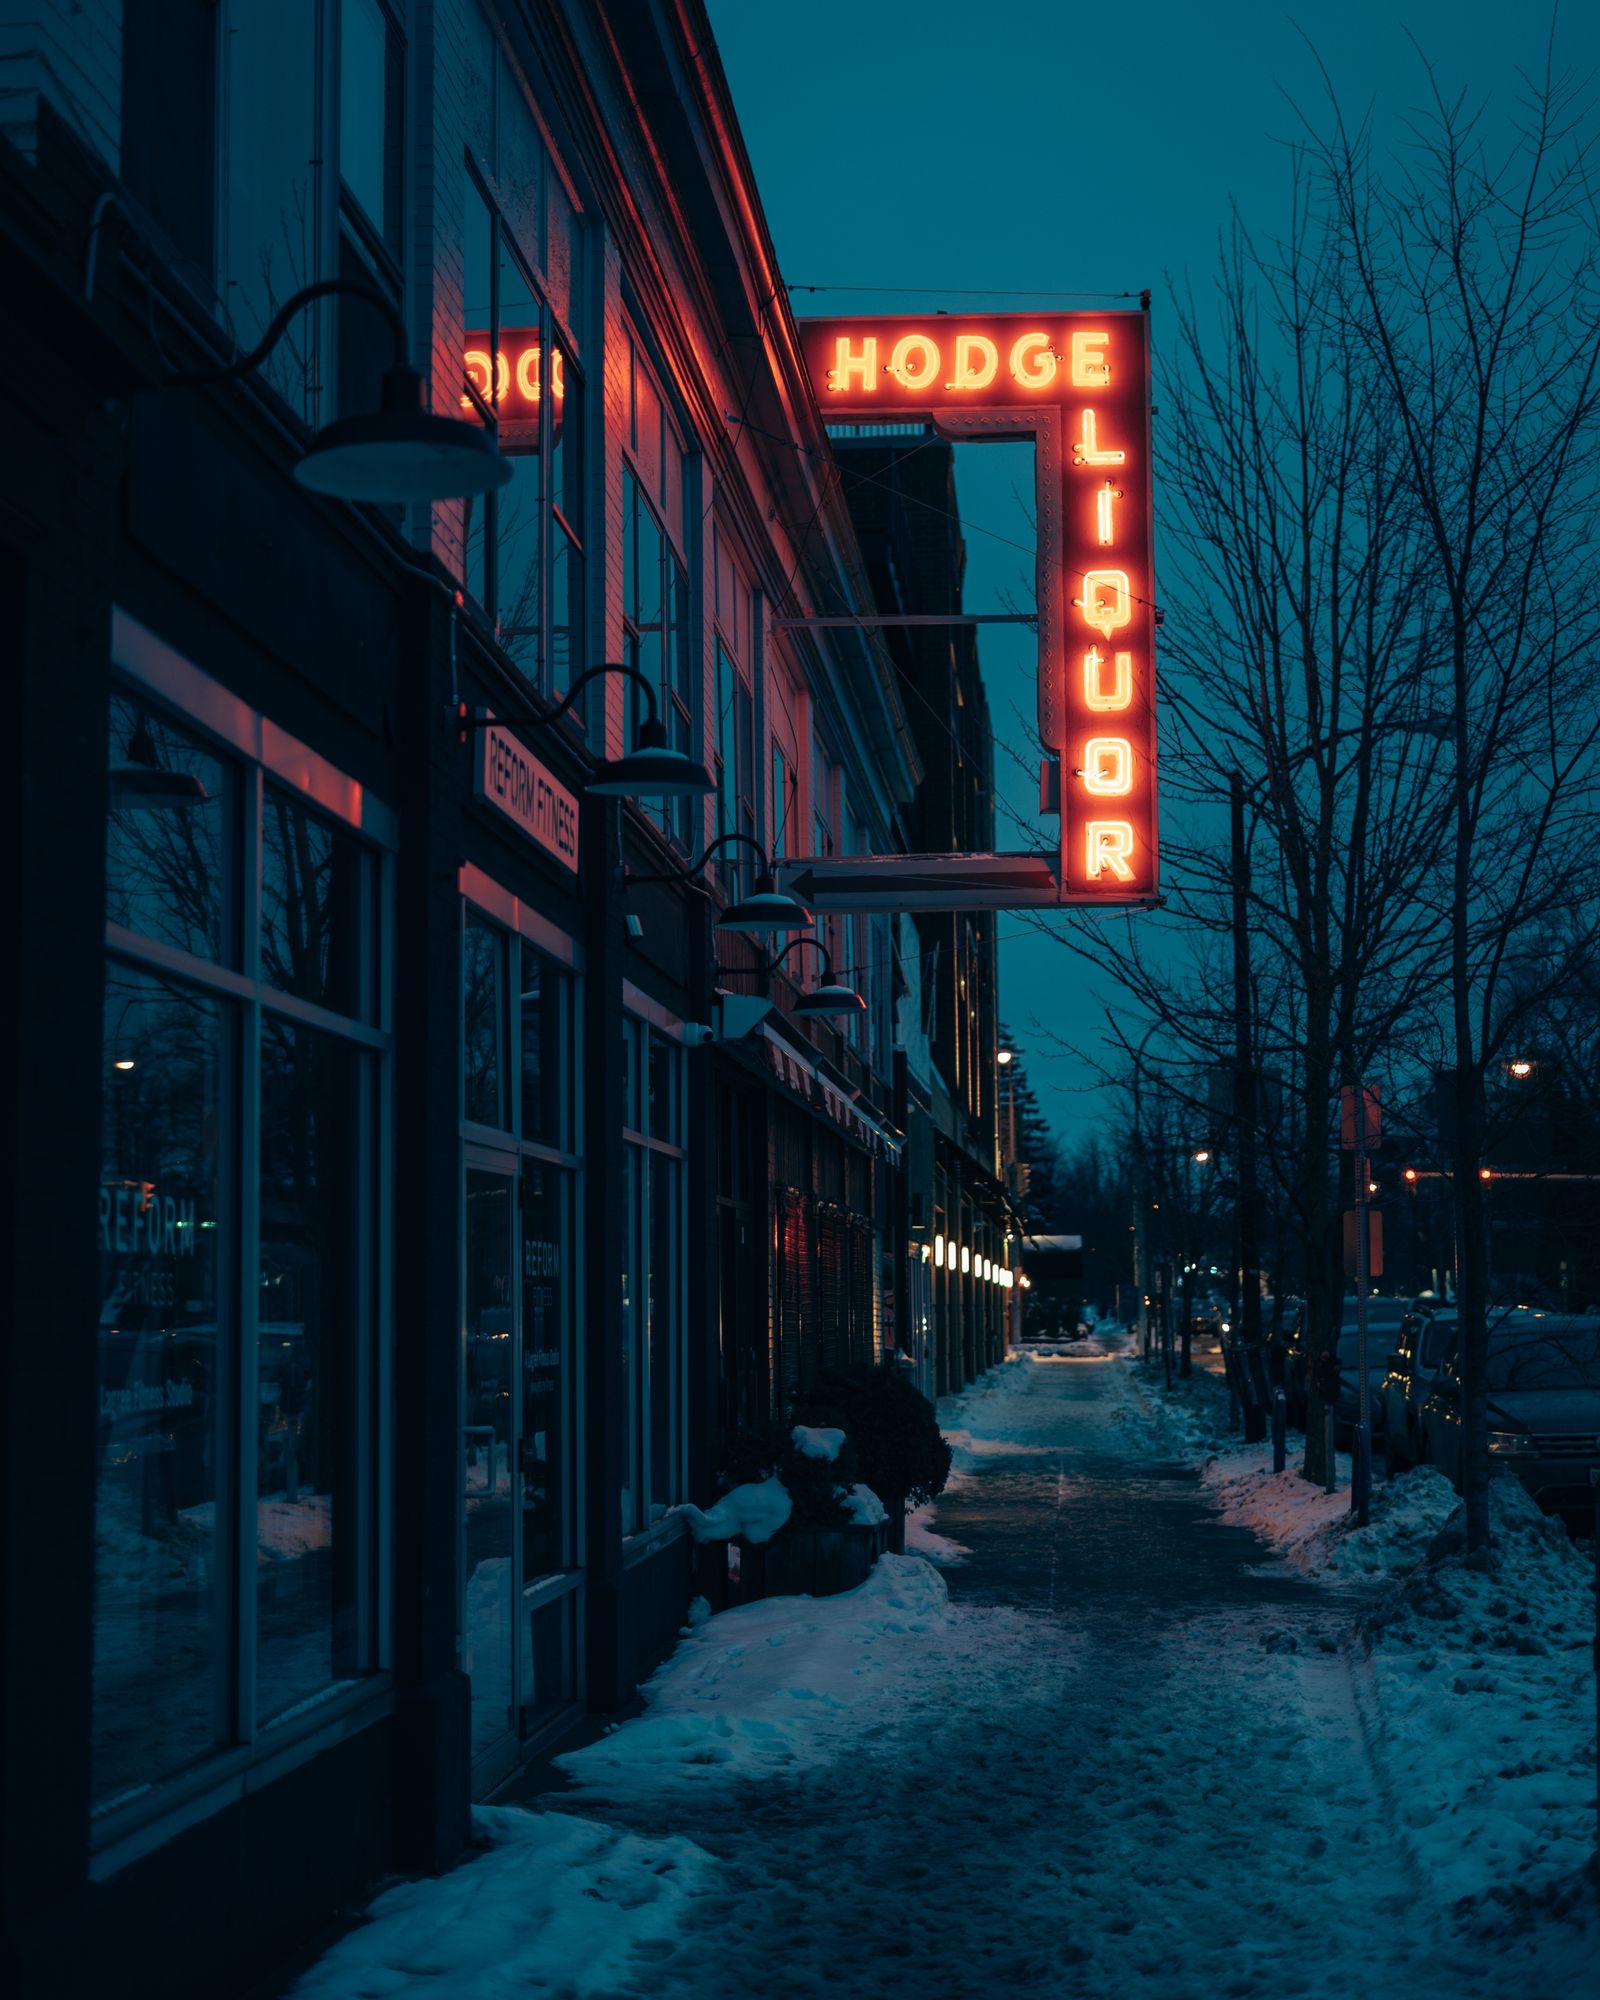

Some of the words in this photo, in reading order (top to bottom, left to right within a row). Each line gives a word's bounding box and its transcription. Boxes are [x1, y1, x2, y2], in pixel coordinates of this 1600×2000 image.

[830, 331, 1111, 392] HODGE
[1078, 408, 1137, 881] LIQUOR
[490, 730, 535, 823] REFORM
[537, 776, 575, 857] FITNESS
[99, 1187, 195, 1256] REFORM
[526, 1240, 559, 1278] REFORM
